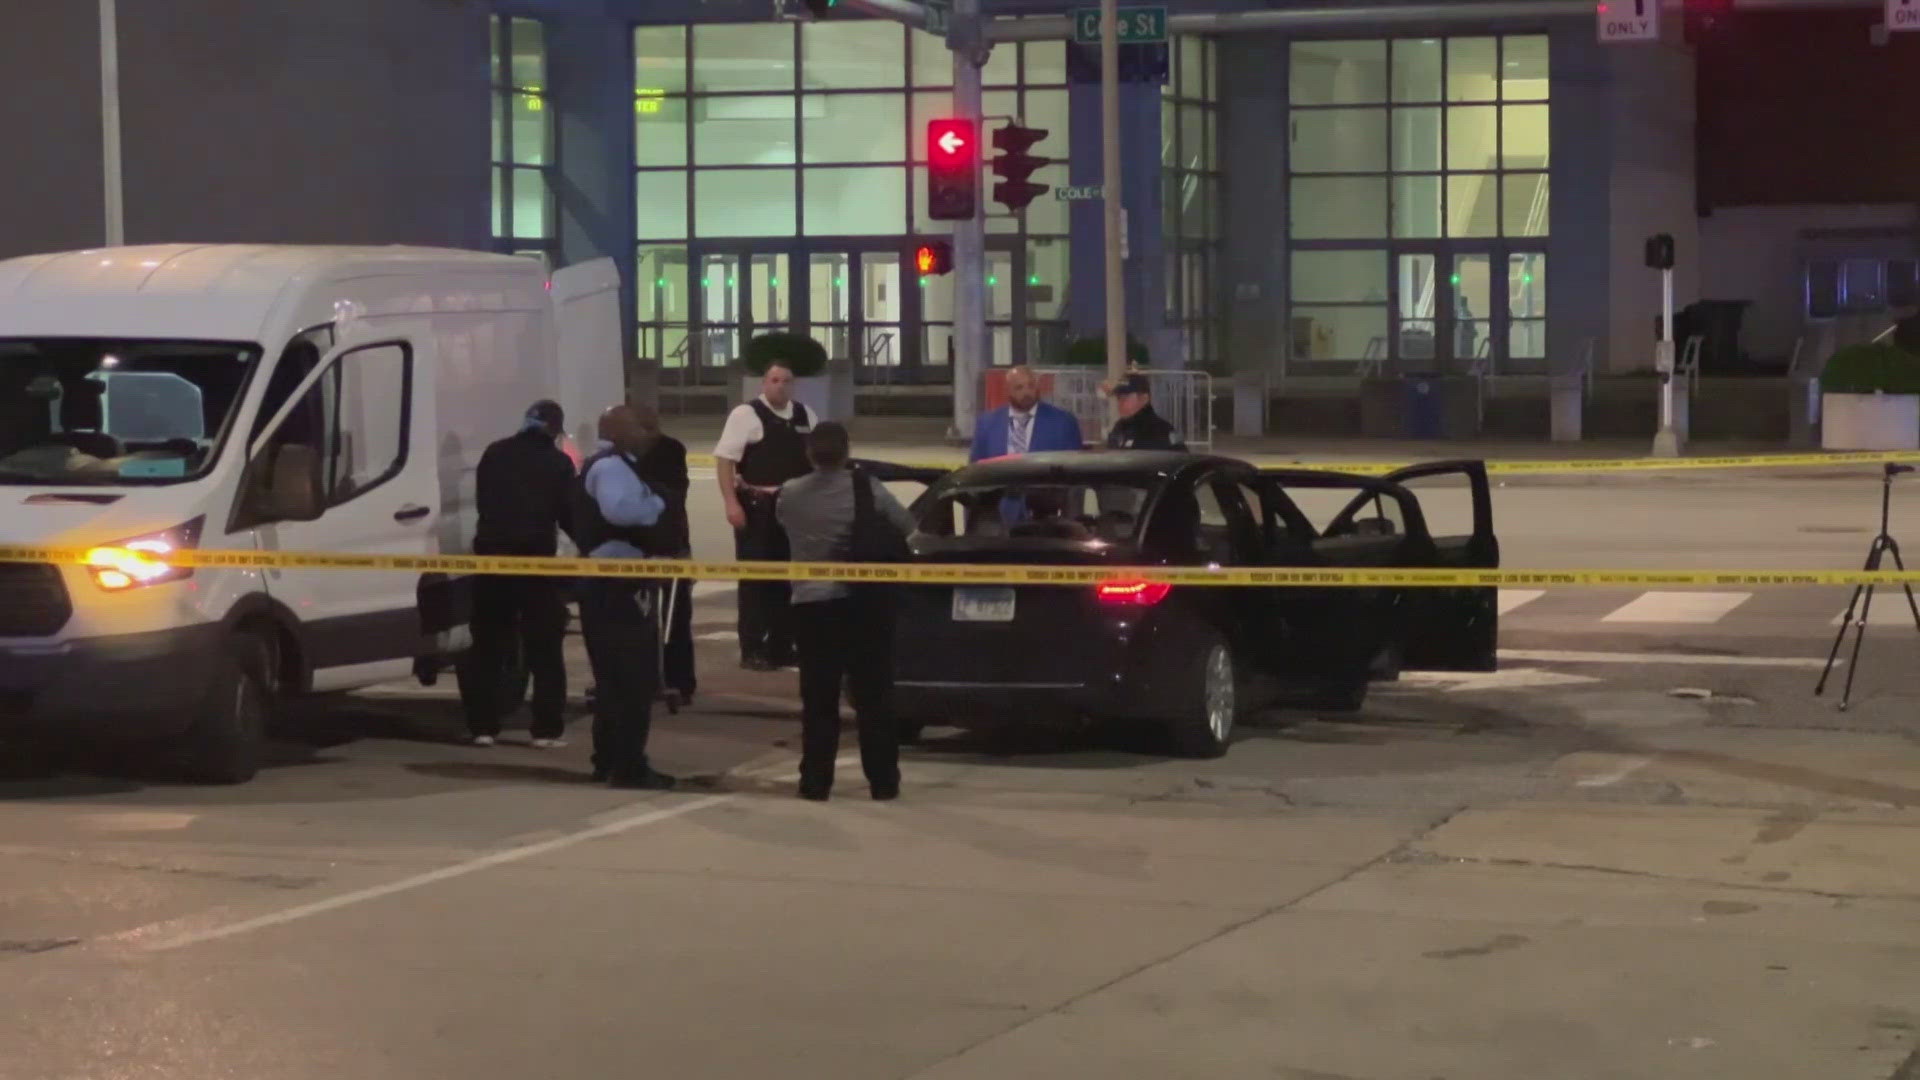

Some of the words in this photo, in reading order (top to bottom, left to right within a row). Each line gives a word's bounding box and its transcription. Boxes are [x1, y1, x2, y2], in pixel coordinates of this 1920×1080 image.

[1084, 13, 1129, 37] Ce
[1136, 13, 1157, 36] St
[1607, 21, 1649, 36] ONLY
[1060, 186, 1092, 199] COLE
